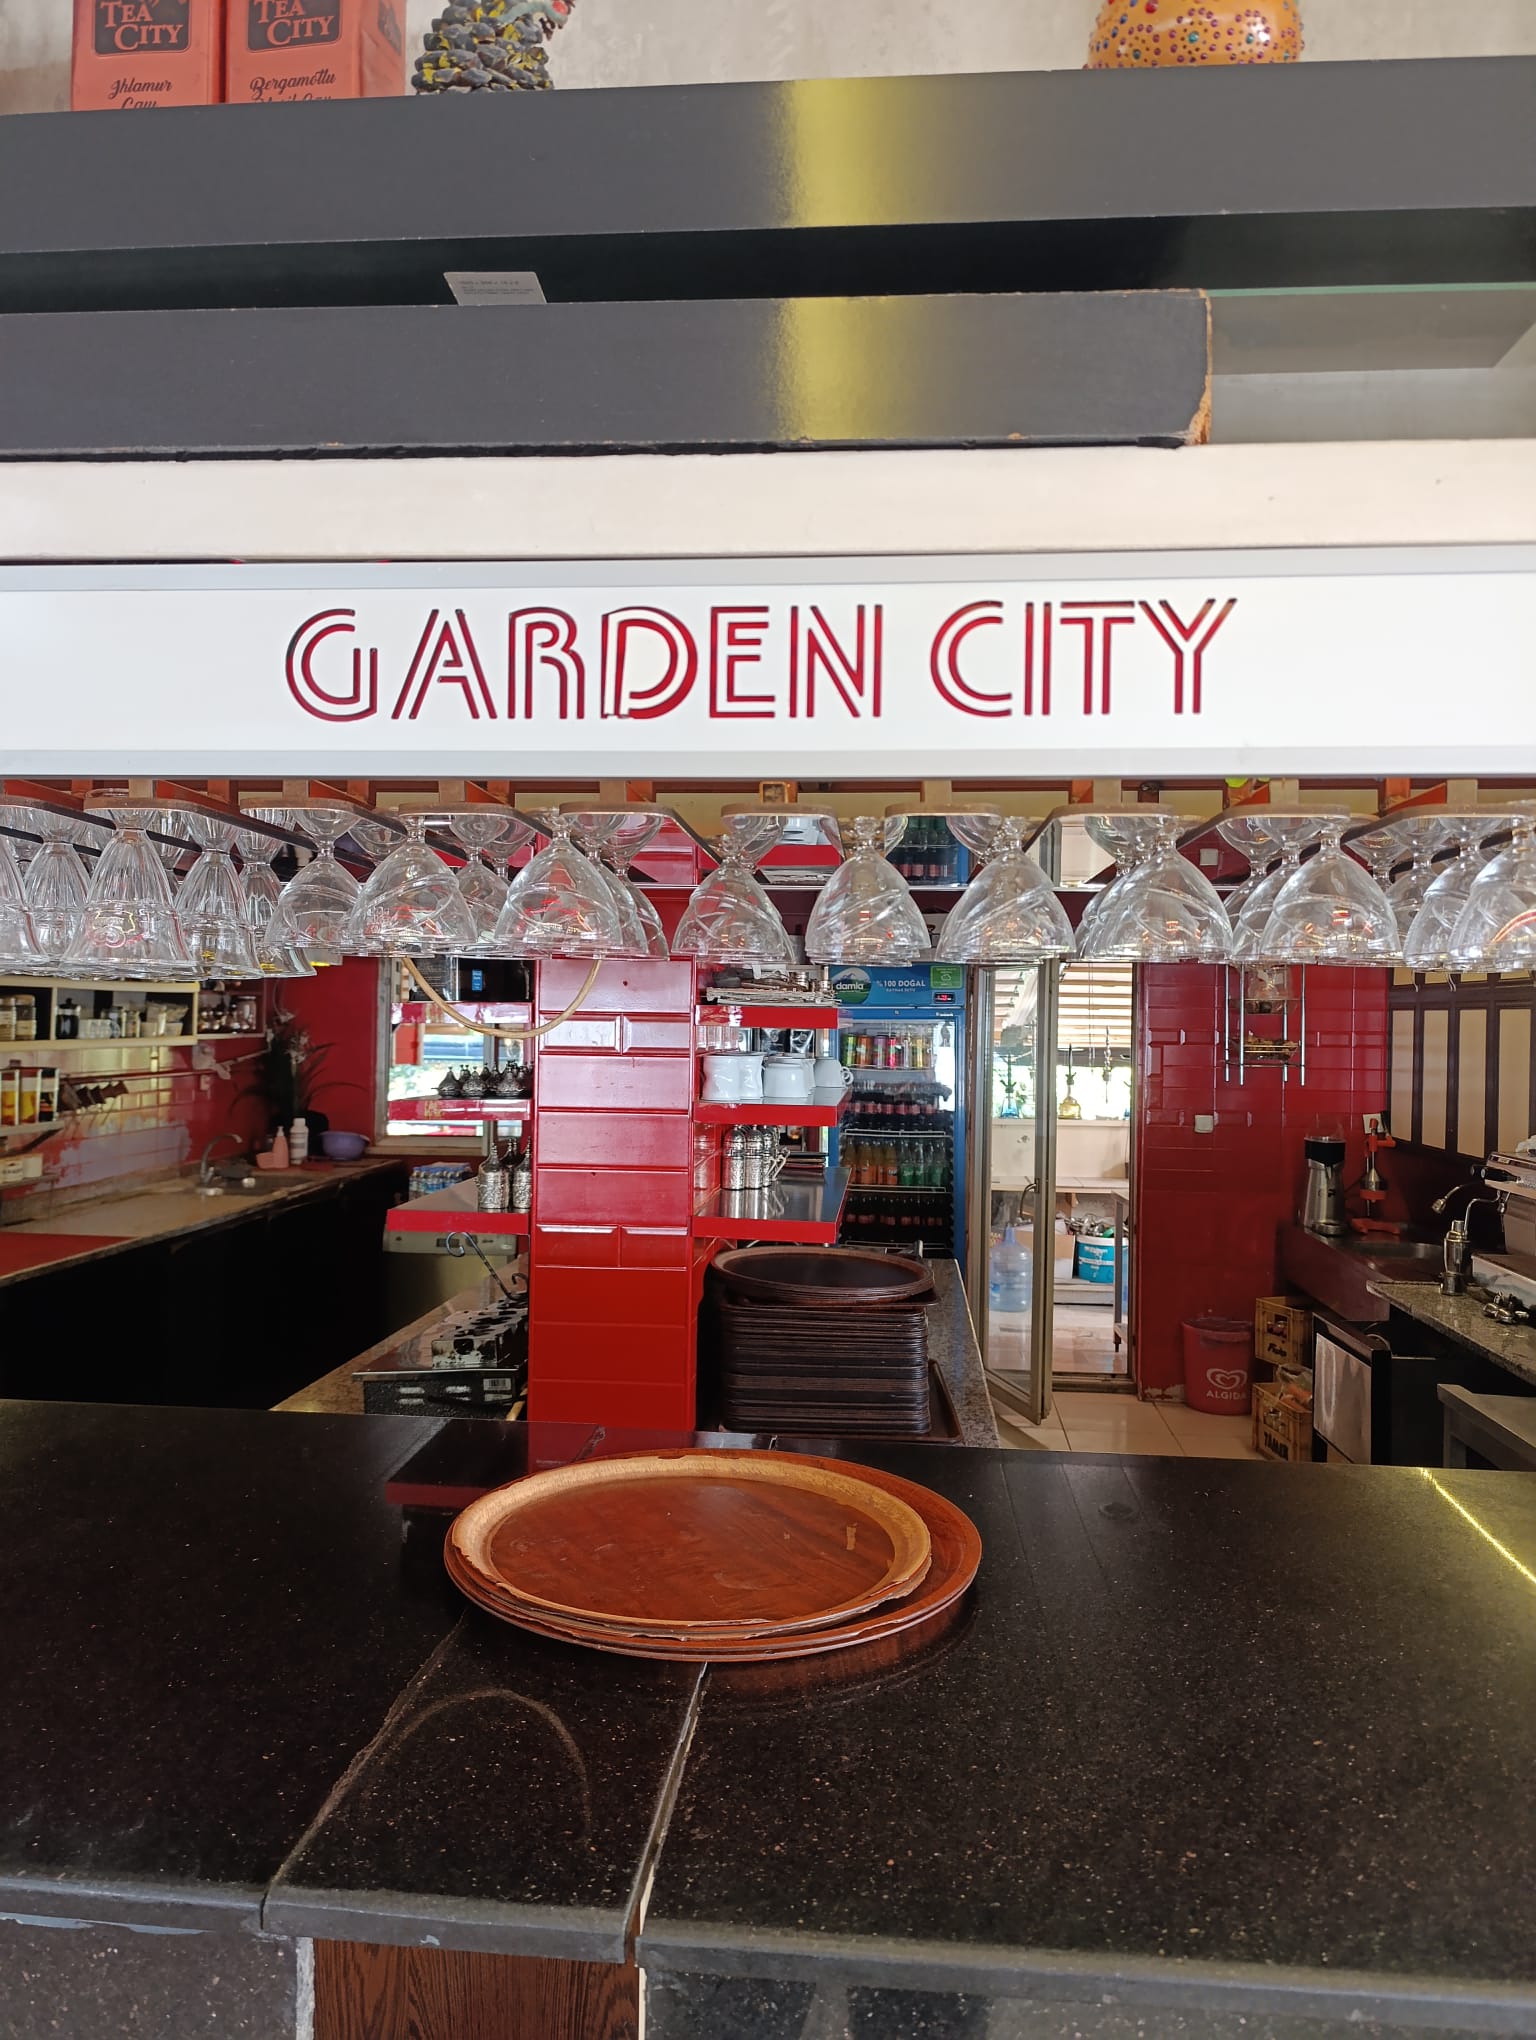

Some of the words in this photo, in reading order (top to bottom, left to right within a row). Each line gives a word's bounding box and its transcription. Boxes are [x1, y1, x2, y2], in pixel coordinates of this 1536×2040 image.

[100, 1, 153, 28] TEA
[253, 0, 305, 24] TEA
[114, 24, 183, 50] CITY
[266, 15, 335, 46] CITY
[249, 68, 336, 95] Bergamotlu
[285, 605, 883, 722] GARDEN
[930, 598, 1238, 718] CITY
[836, 982, 864, 990] damla
[898, 979, 926, 987] DOĞAL
[1206, 1389, 1247, 1400] ALGIDA
